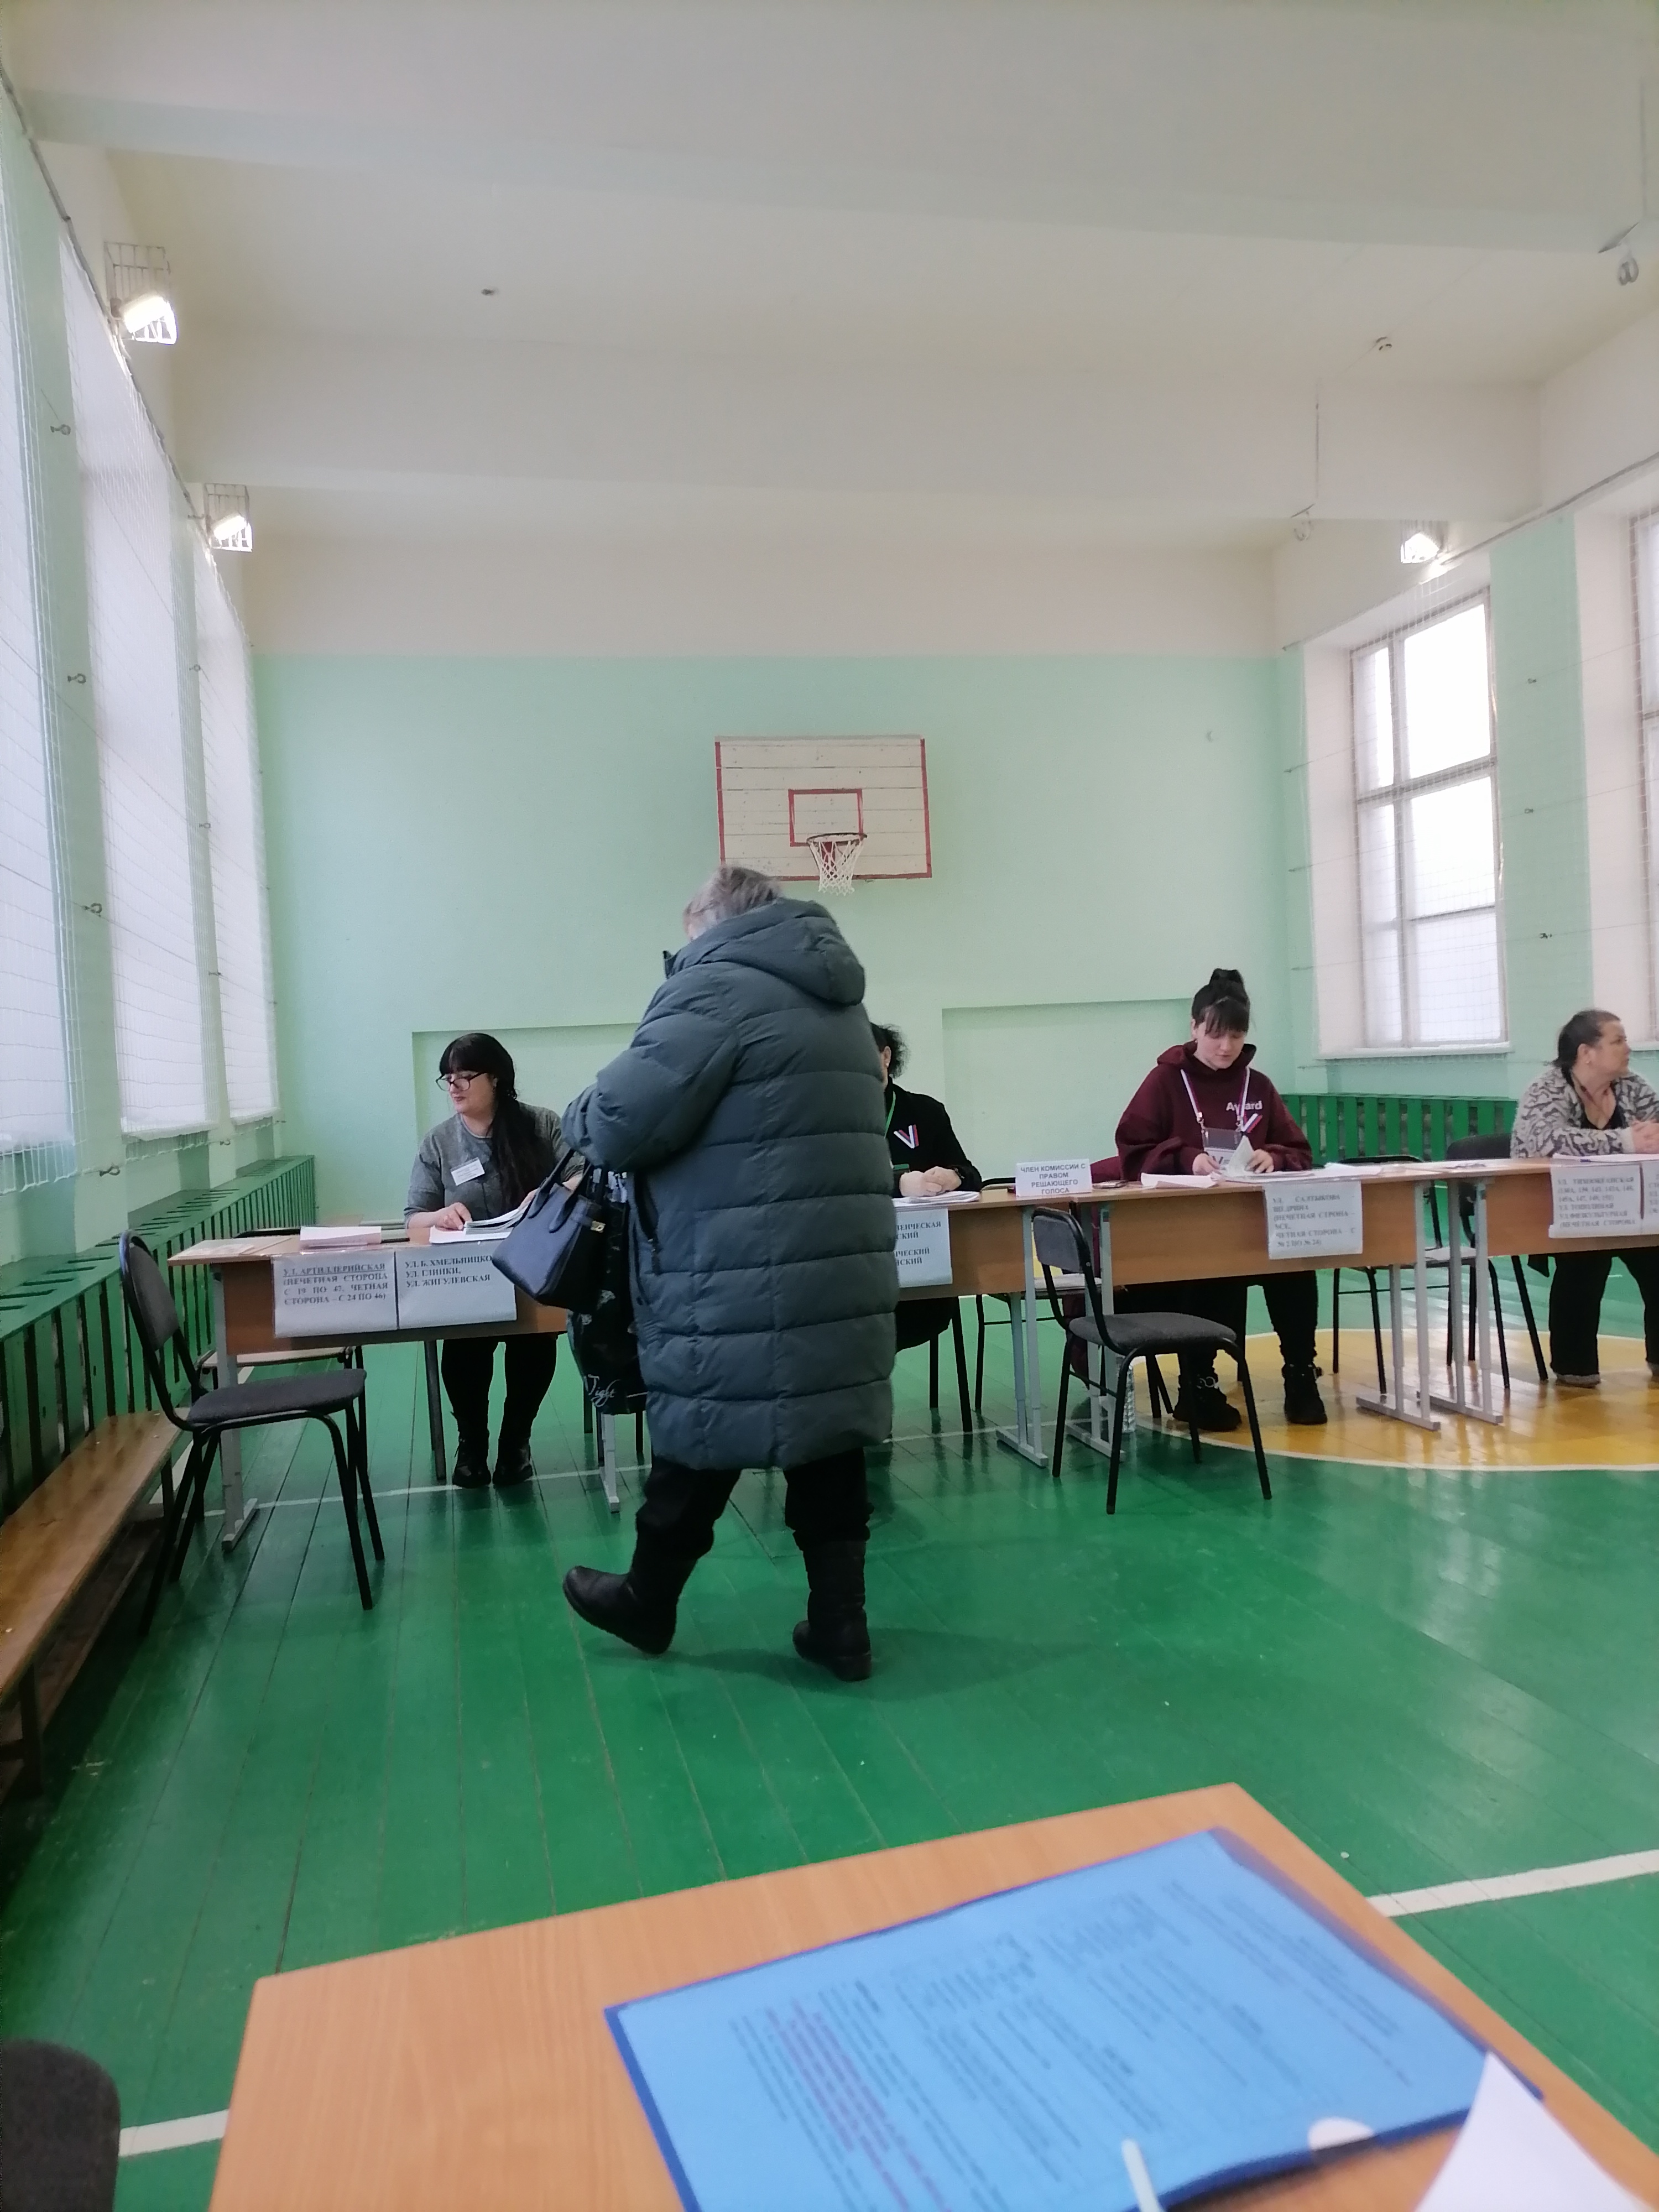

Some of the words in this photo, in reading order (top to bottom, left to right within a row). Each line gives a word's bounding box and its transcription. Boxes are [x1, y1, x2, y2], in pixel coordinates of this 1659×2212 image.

[1031, 1179, 1078, 1188] РЕШАЮЩЕГО
[896, 1221, 941, 1231] ЕНЧЕСКАЯ
[896, 1231, 919, 1239] СКИЙ
[896, 1246, 930, 1257] ЧЕСКИЙ
[430, 1255, 492, 1266] ХМЕЛЬНИЦКО
[896, 1256, 922, 1266] СКИЙ
[301, 1263, 385, 1274] АРТИЛЛЕРИЙСКАЯ
[283, 1276, 337, 1286] (НЕЧЕТНАЯ
[343, 1272, 387, 1282] СТОРОНА
[422, 1274, 491, 1286] ЖИГУЛЕВСКАЯ
[351, 1282, 388, 1291] ЧЕТНАЯ
[284, 1297, 329, 1305] СТОРОНА
